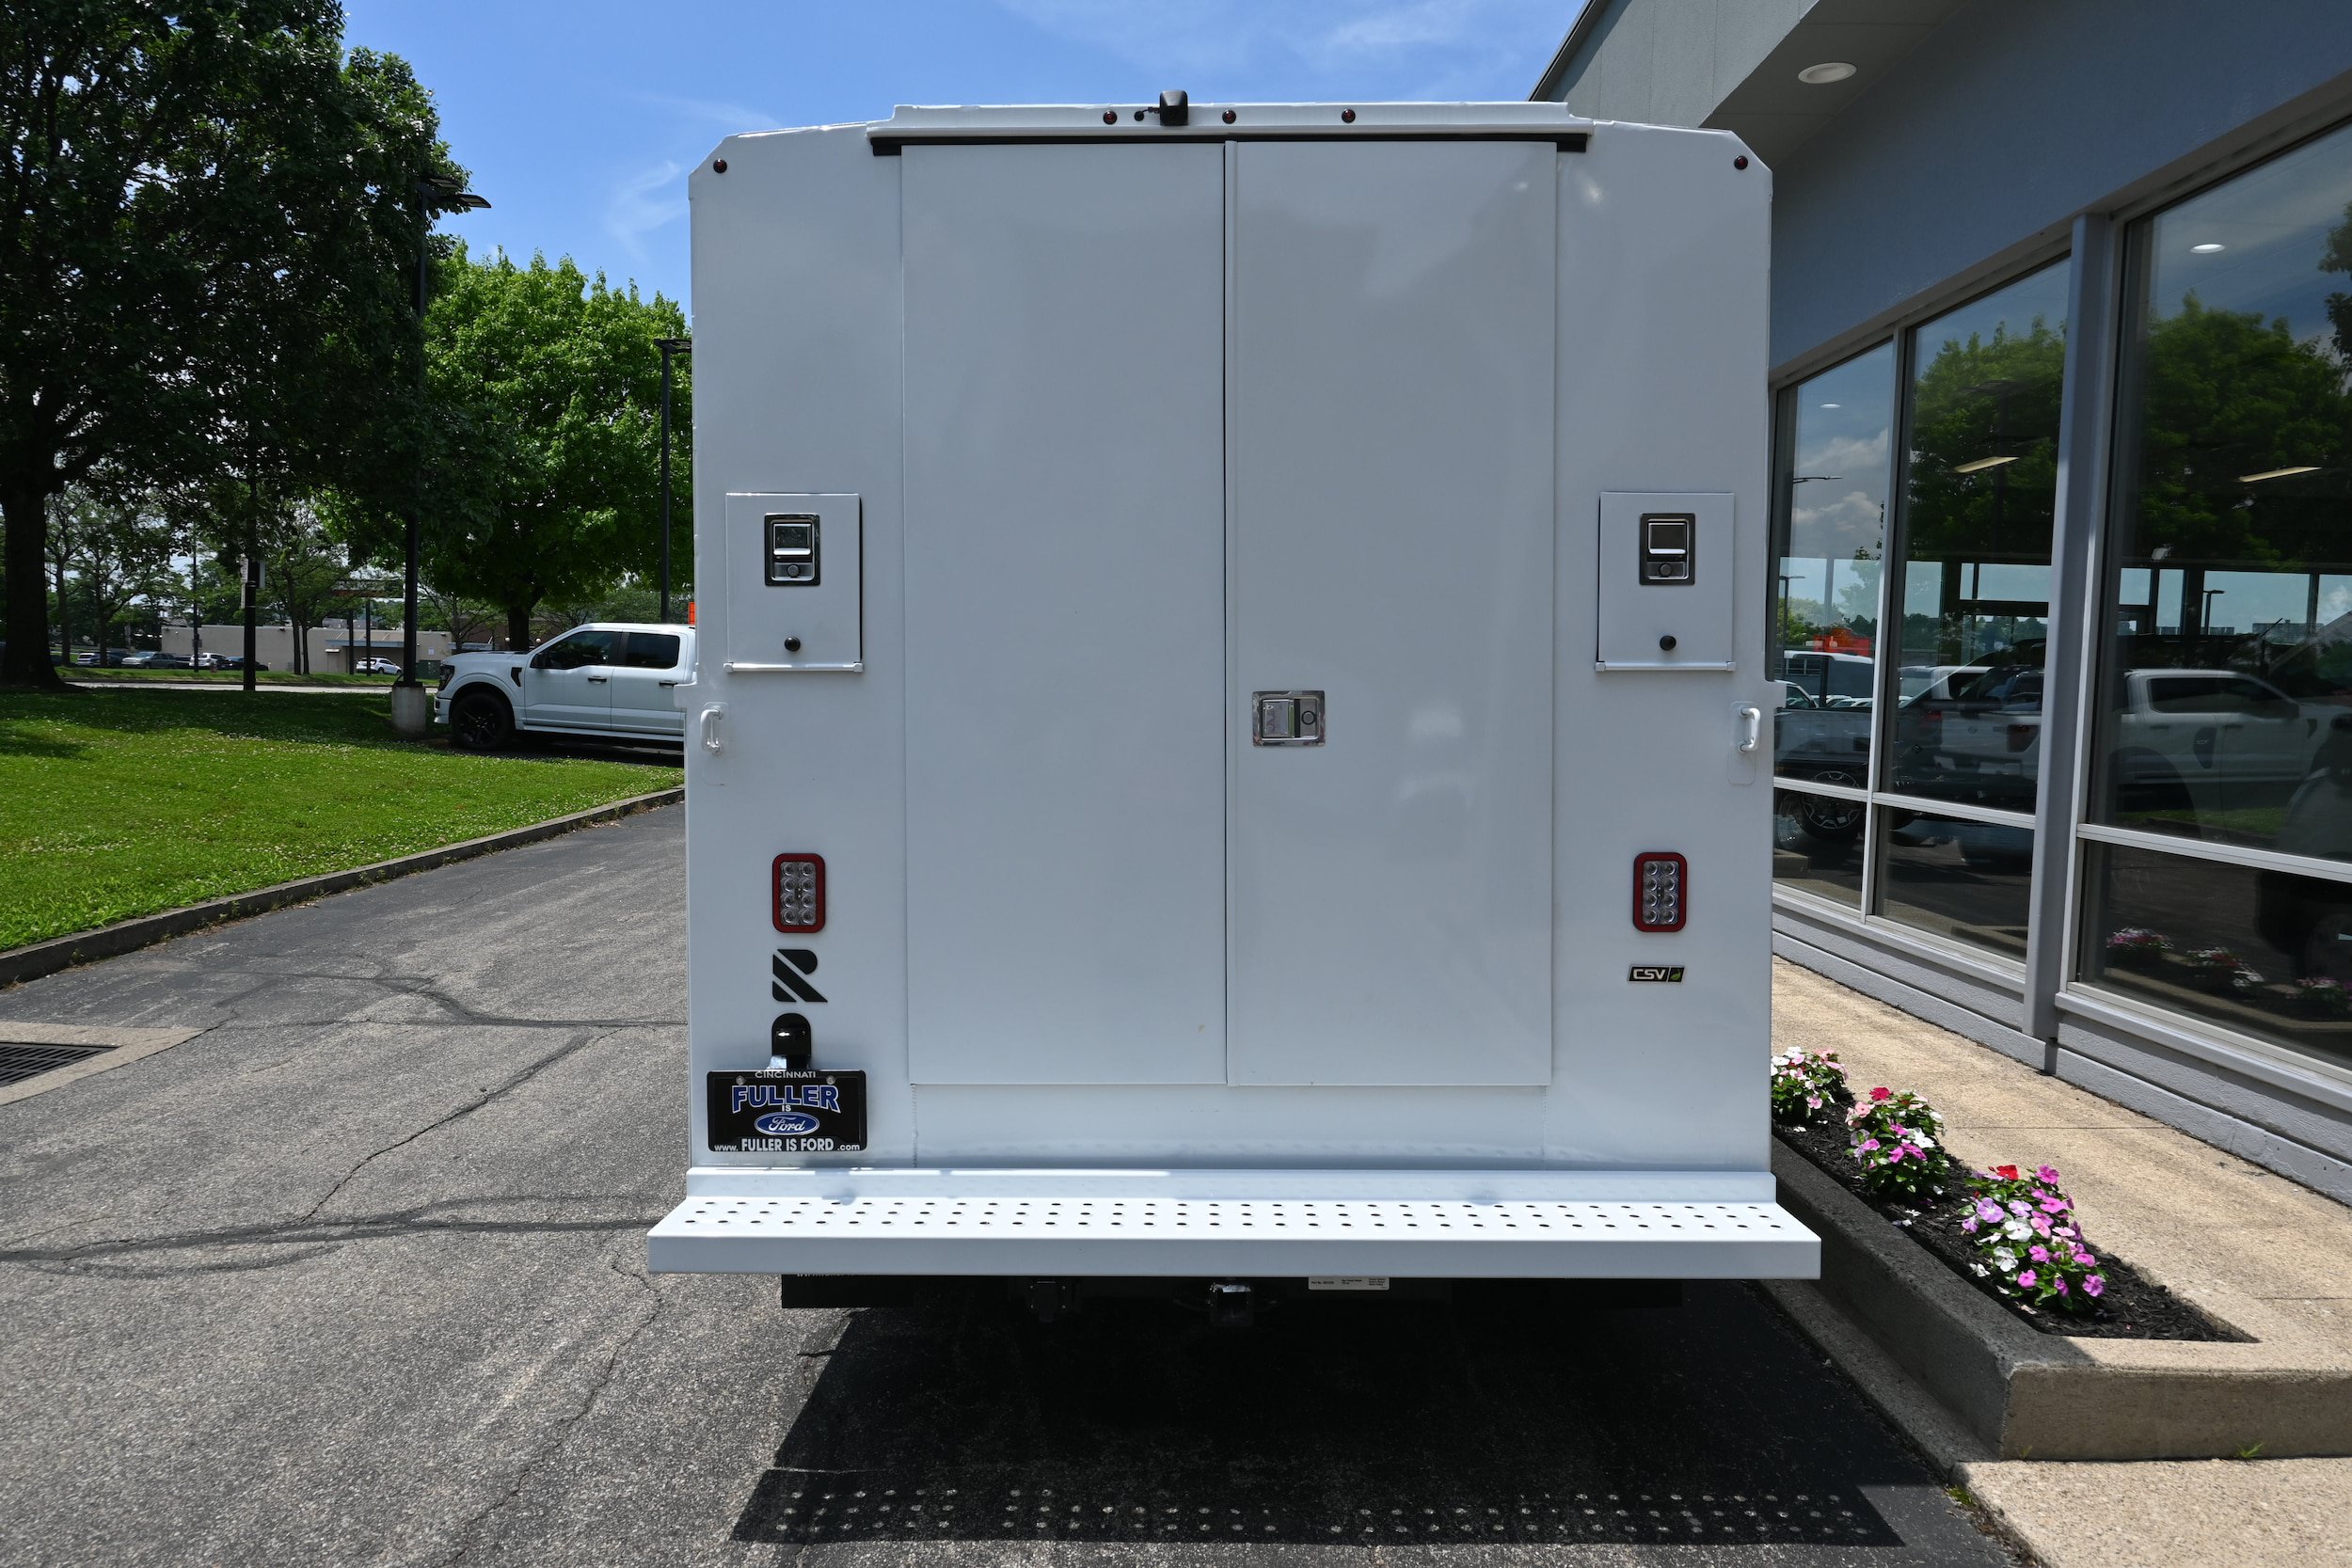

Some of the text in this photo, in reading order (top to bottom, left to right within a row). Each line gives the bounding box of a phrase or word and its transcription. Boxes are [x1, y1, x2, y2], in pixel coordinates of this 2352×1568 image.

[1632, 968, 1666, 980] CSV
[755, 1070, 817, 1079] CINCINNATI
[731, 1085, 841, 1114] FULLER
[768, 1116, 806, 1132] Ford
[714, 1138, 860, 1152] www. FULLER IS FORD .com
